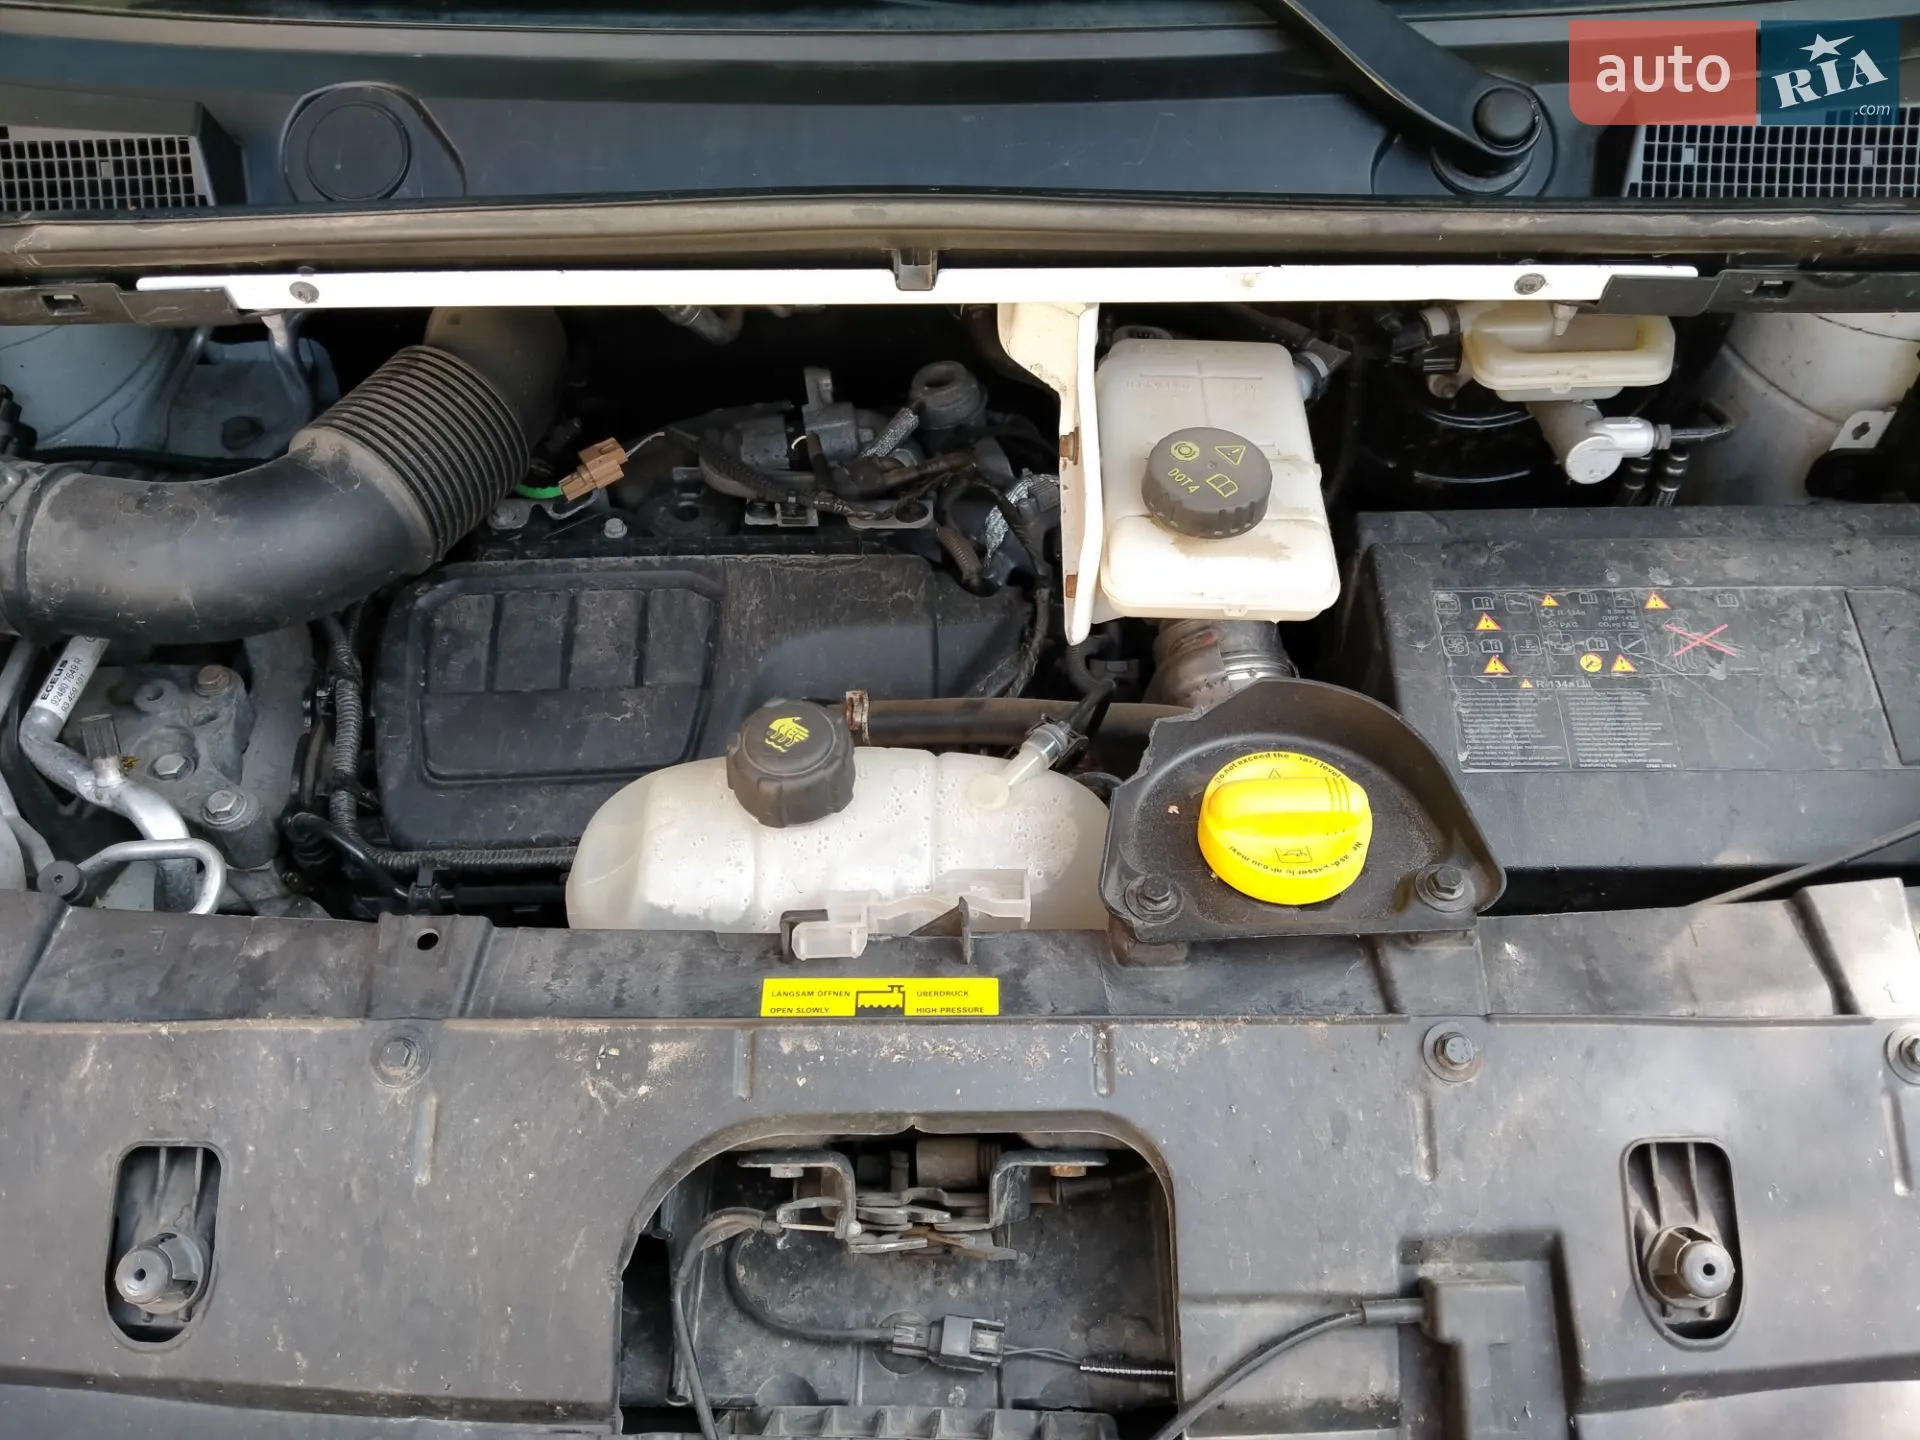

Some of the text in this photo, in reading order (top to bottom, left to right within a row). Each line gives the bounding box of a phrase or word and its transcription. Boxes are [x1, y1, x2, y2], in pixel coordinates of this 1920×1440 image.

[1167, 467, 1200, 494] DOT 4
[1224, 762, 1238, 775] not
[1237, 752, 1271, 766] exceed
[1319, 762, 1342, 779] level
[771, 990, 815, 998] LANGSAM
[940, 1006, 985, 1014] PRESSURE
